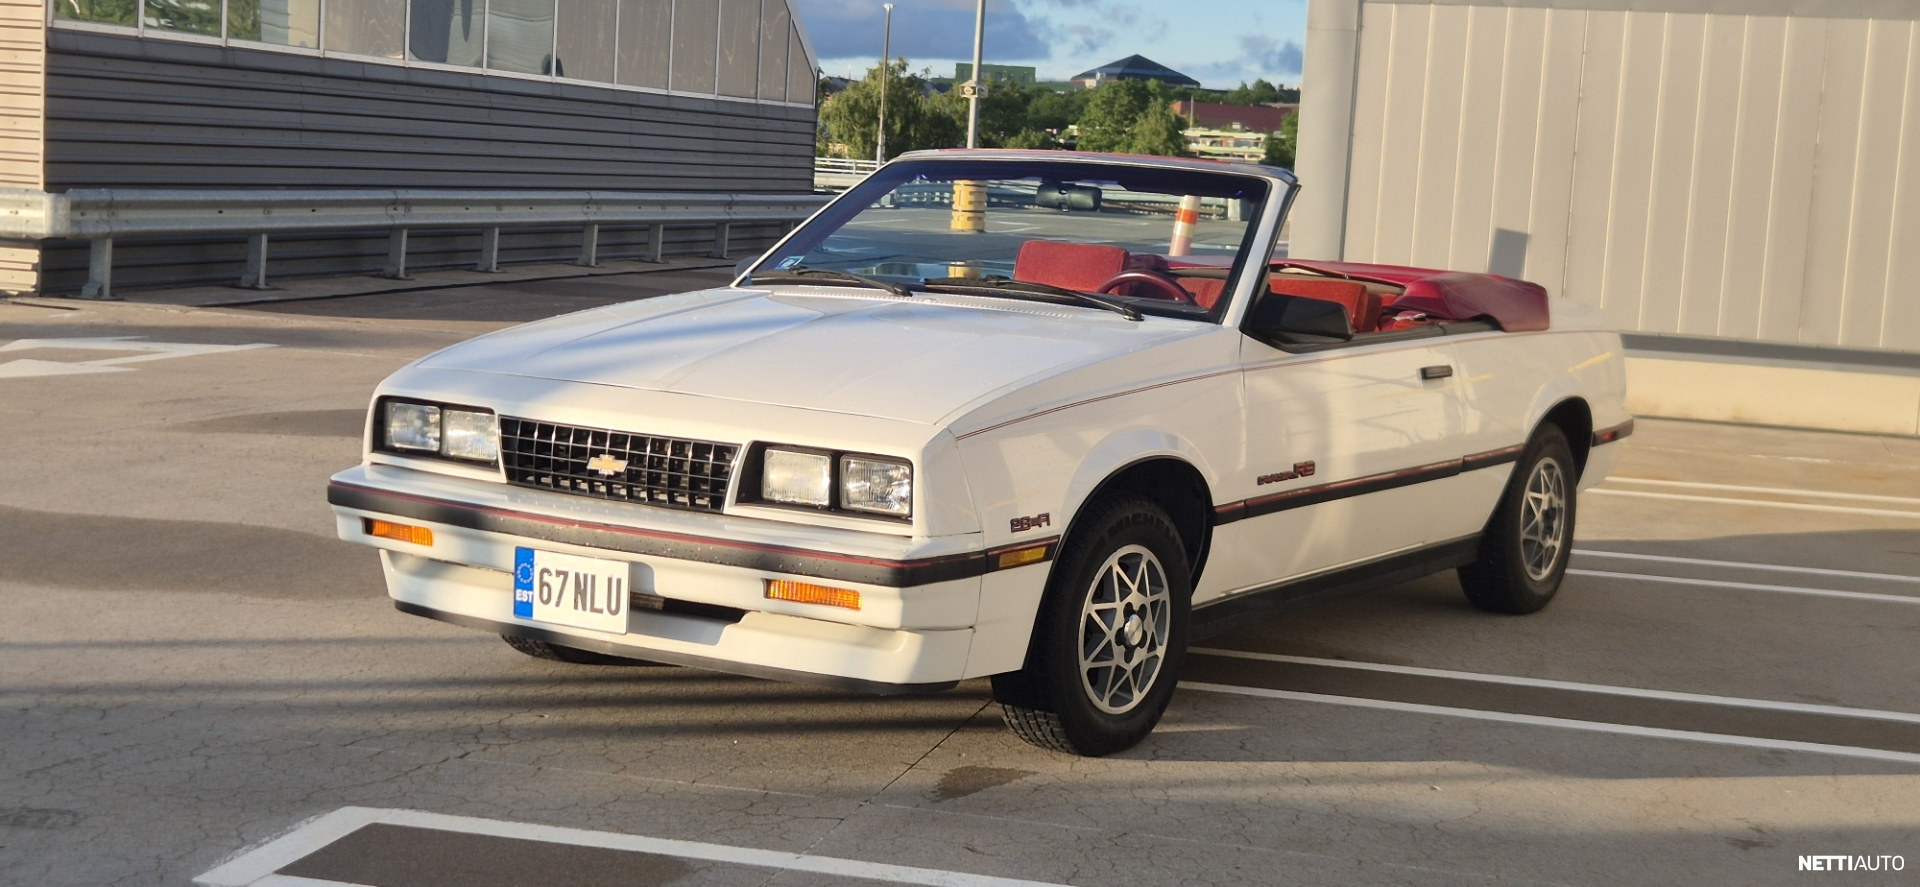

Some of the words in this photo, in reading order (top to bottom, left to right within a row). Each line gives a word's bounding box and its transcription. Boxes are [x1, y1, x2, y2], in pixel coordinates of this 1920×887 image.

[515, 588, 534, 603] EST
[539, 567, 569, 608] 67
[573, 571, 622, 616] NLU
